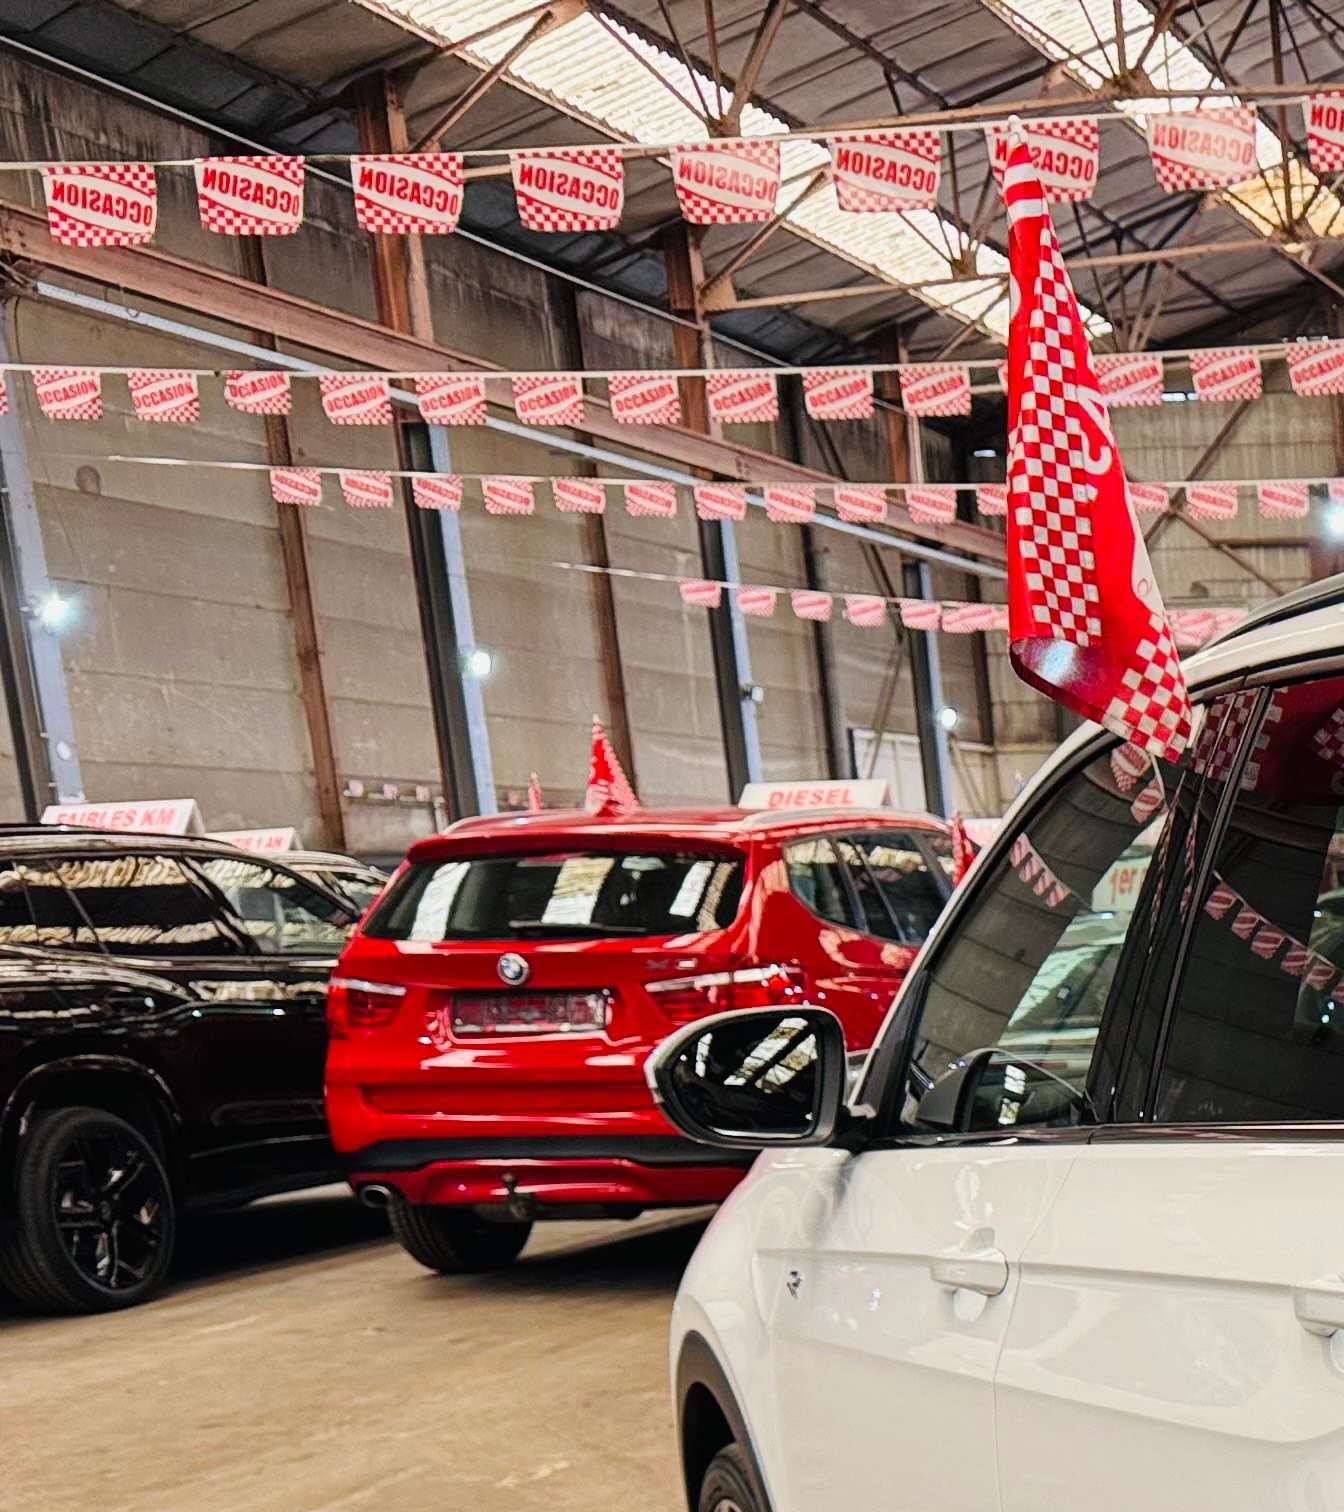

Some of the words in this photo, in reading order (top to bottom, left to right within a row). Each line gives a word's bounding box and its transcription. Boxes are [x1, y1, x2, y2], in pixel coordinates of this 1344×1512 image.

[39, 380, 98, 407] OCCASION
[134, 383, 194, 409] OCCASION
[327, 384, 384, 410] OCCASION
[421, 384, 482, 412] OCCASION
[519, 384, 578, 410] OCCASION
[615, 383, 674, 412] OCCASION
[768, 788, 855, 809] DIESEL
[142, 806, 176, 826] KM
